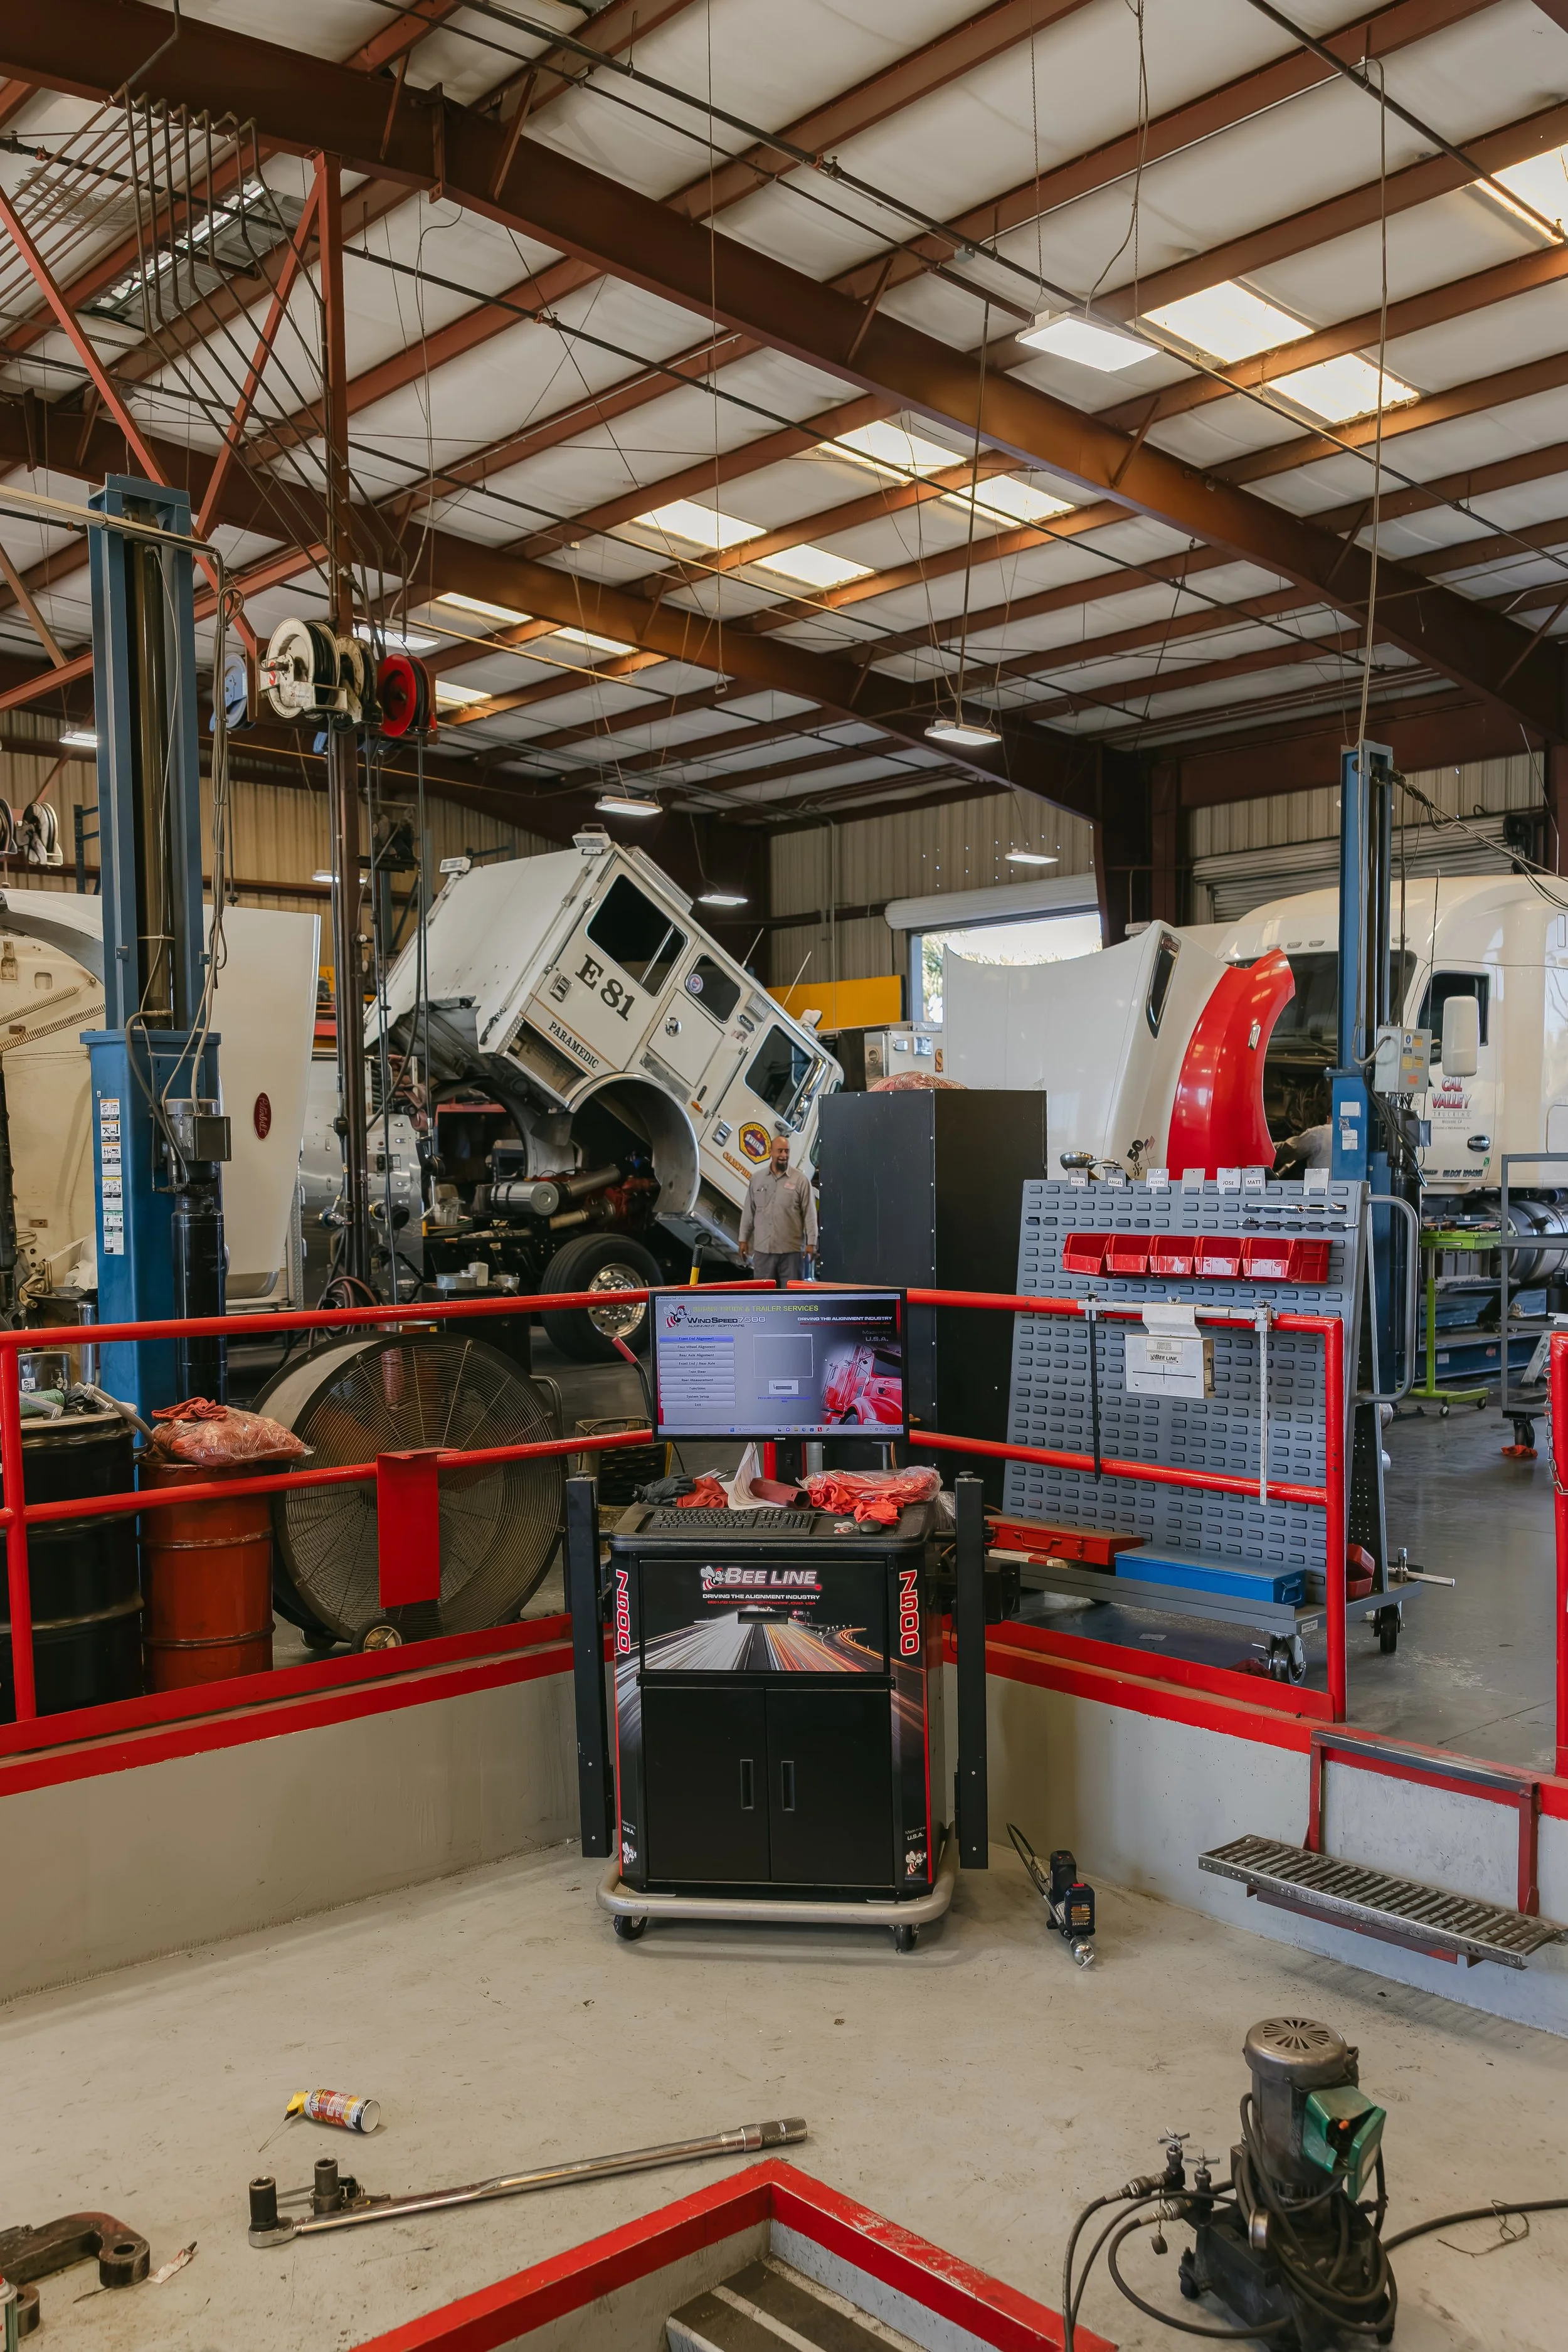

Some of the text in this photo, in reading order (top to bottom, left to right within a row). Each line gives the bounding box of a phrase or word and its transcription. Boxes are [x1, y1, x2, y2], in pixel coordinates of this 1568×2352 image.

[575, 954, 635, 1022] E 81
[548, 1020, 599, 1069] PARAMEDIC
[1431, 1093, 1472, 1109] VALLEY
[1442, 1077, 1463, 1092] CAL
[724, 1567, 817, 1584] BEE LINE
[616, 1569, 631, 1654] 7500
[899, 1569, 919, 1656] 7500
[907, 1832, 924, 1840] U.S.A.
